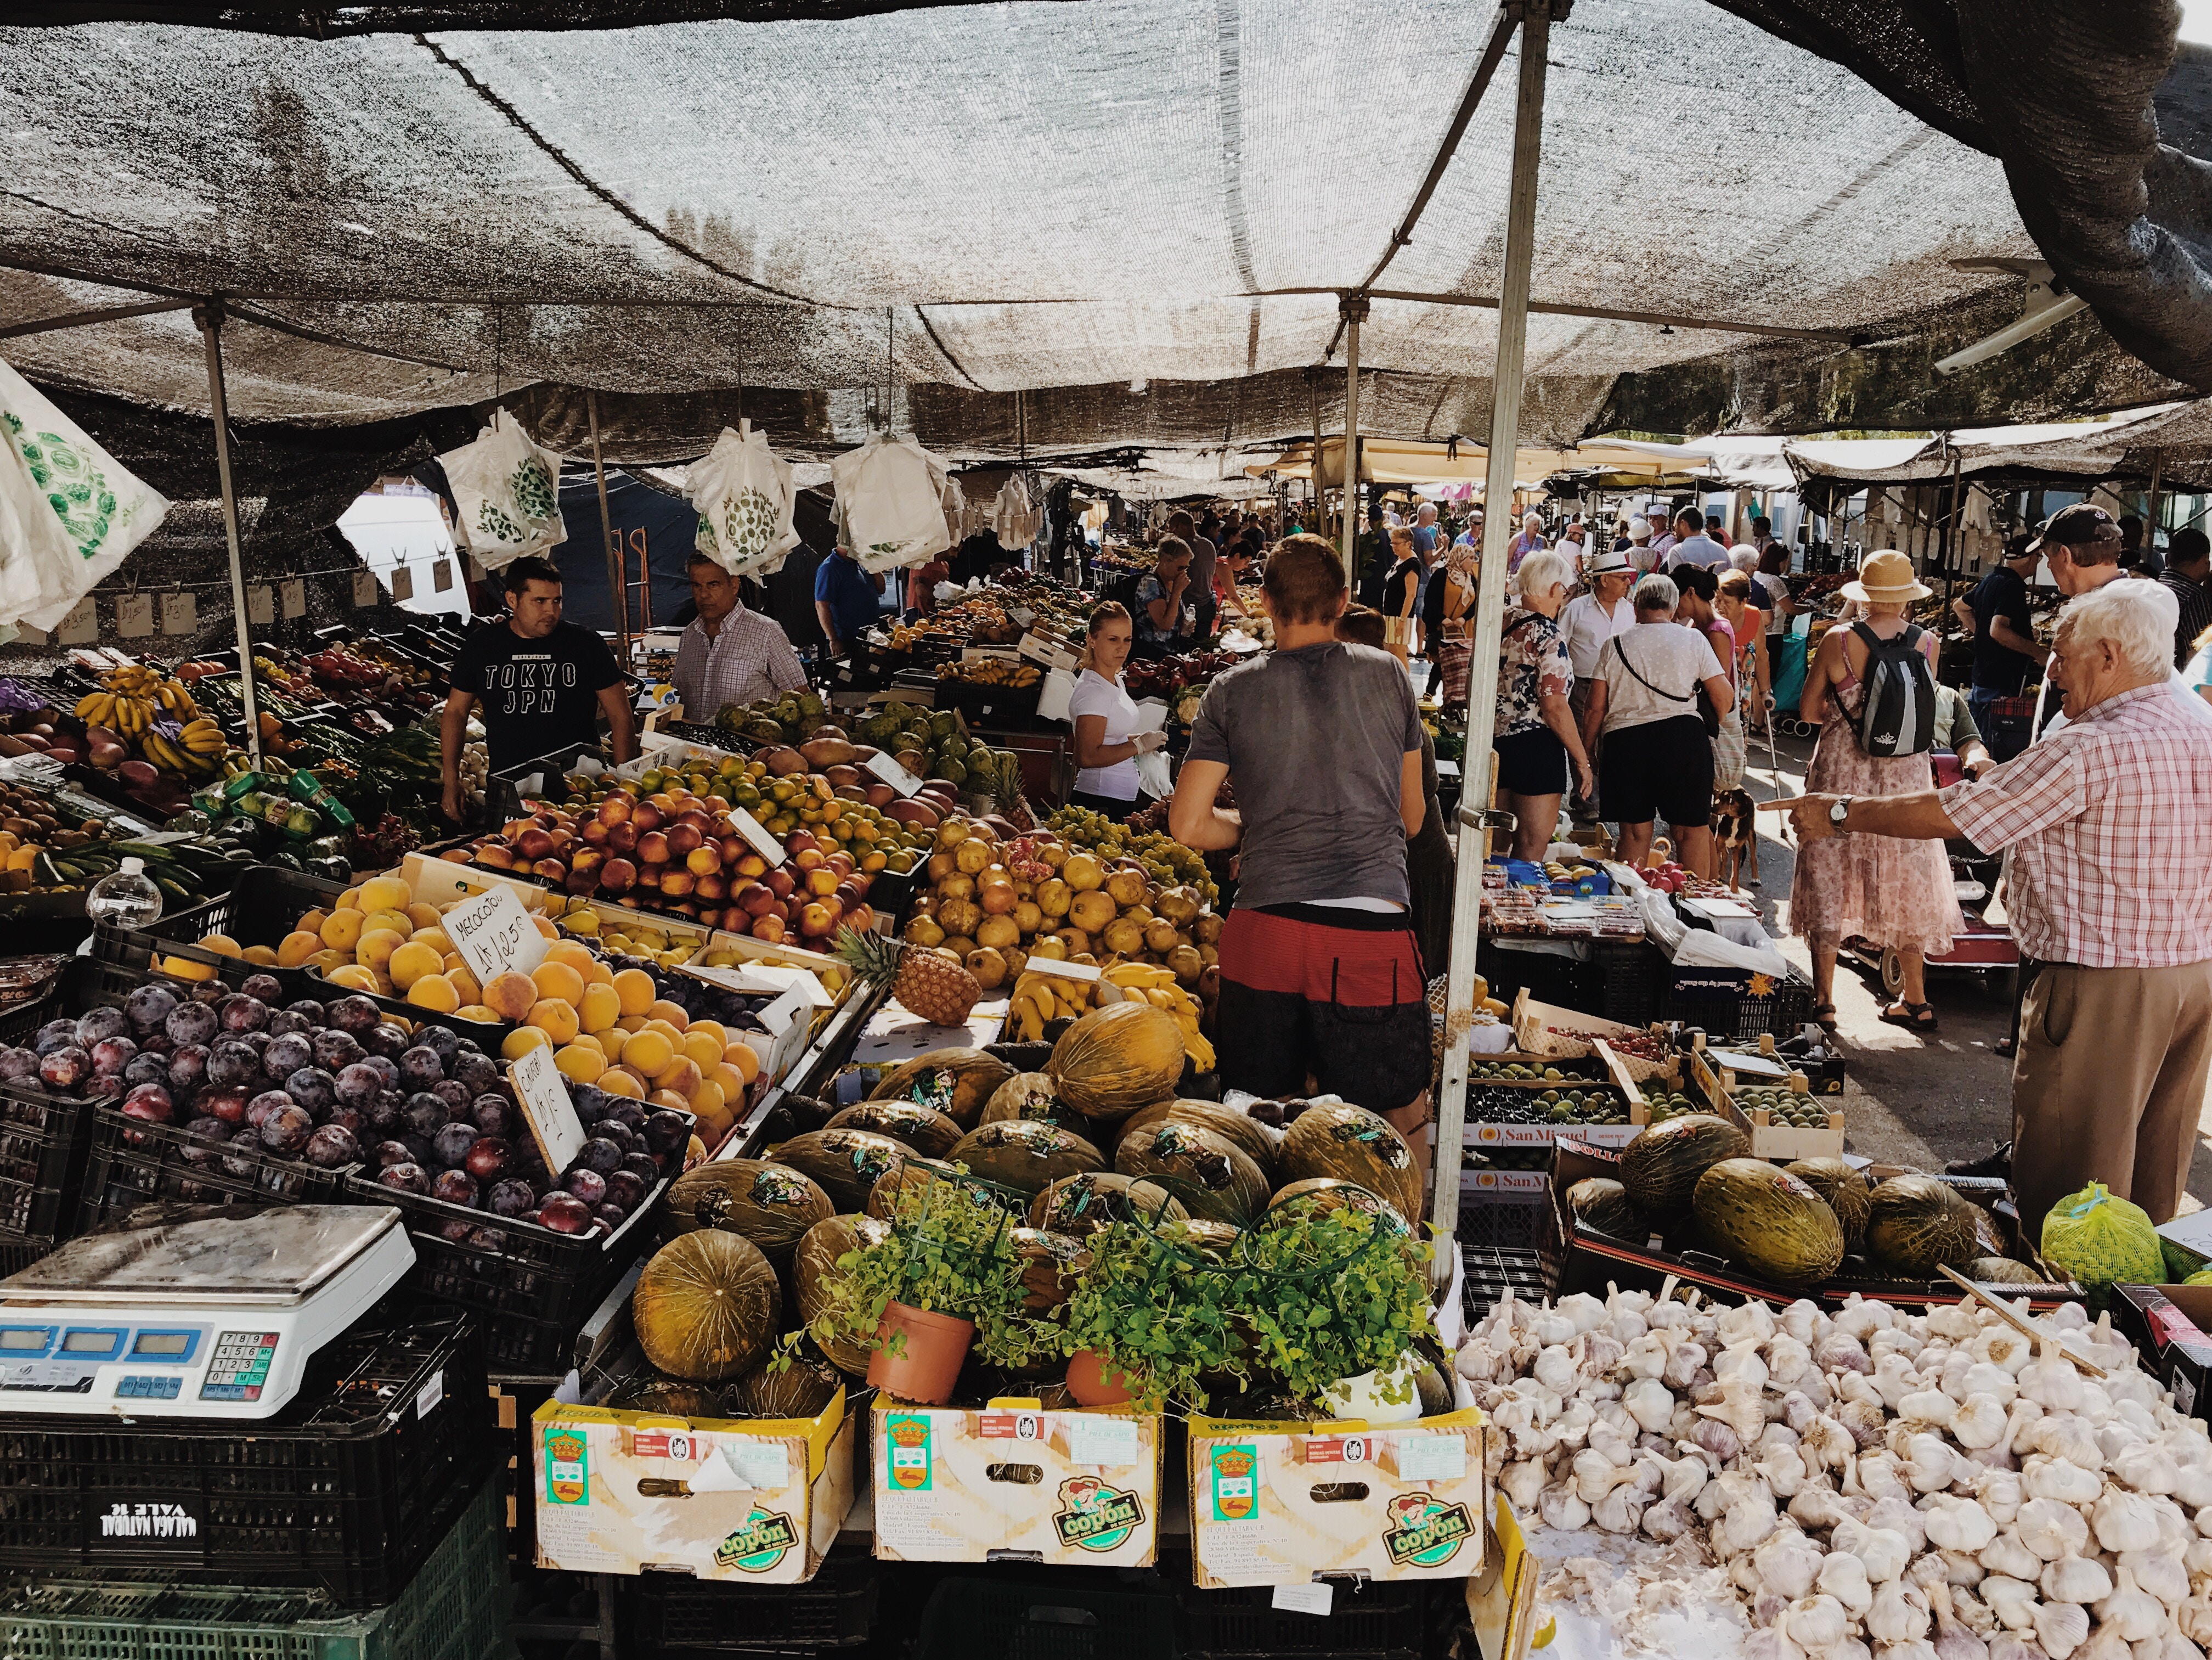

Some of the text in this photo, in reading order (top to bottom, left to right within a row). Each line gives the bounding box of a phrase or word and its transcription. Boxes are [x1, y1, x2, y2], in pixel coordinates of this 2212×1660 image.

[486, 663, 576, 690] TOKYO
[503, 690, 555, 714] JPN
[455, 895, 503, 942] MELOCOTON
[1505, 1129, 1533, 1141] San
[1503, 1175, 1531, 1188] San
[134, 1504, 186, 1516] VALE
[1064, 1502, 1136, 1535] copón
[99, 1515, 196, 1538] MALAGA NATURAL
[1118, 1517, 1137, 1526] MELON
[720, 1522, 789, 1555] copón
[772, 1538, 789, 1548] MELON
[1394, 1516, 1466, 1552] copón
[1447, 1529, 1466, 1539] MELON
[1395, 1550, 1411, 1560] SERIE
